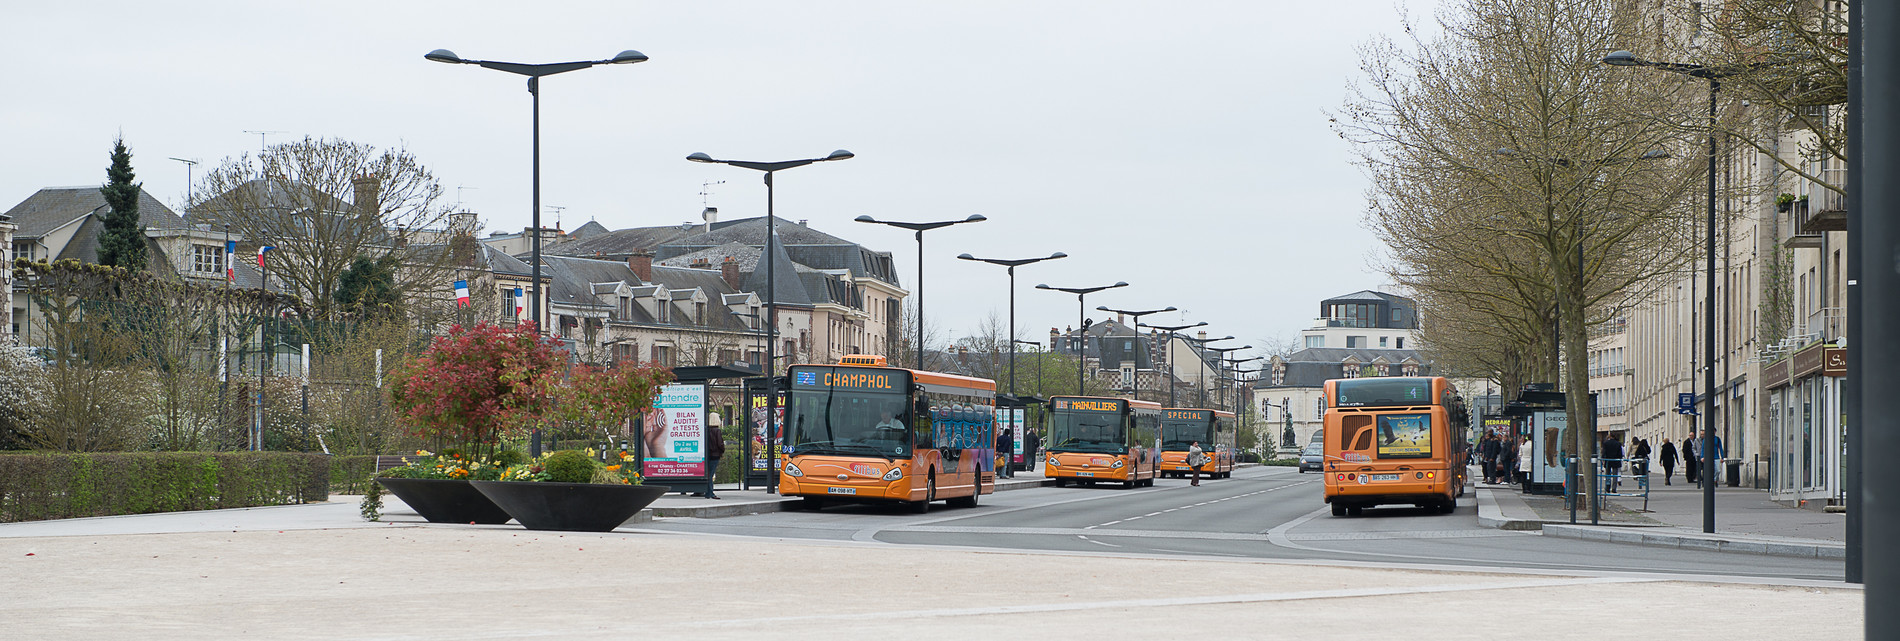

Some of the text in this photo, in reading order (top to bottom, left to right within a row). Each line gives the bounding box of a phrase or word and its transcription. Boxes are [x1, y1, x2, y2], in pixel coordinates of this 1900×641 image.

[802, 372, 892, 389] 2 CHAMPHOL
[1410, 387, 1417, 399] 4
[1072, 400, 1117, 411] MAINVILLIERS
[1167, 411, 1202, 420] SPECIAL
[1360, 475, 1367, 484] 70
